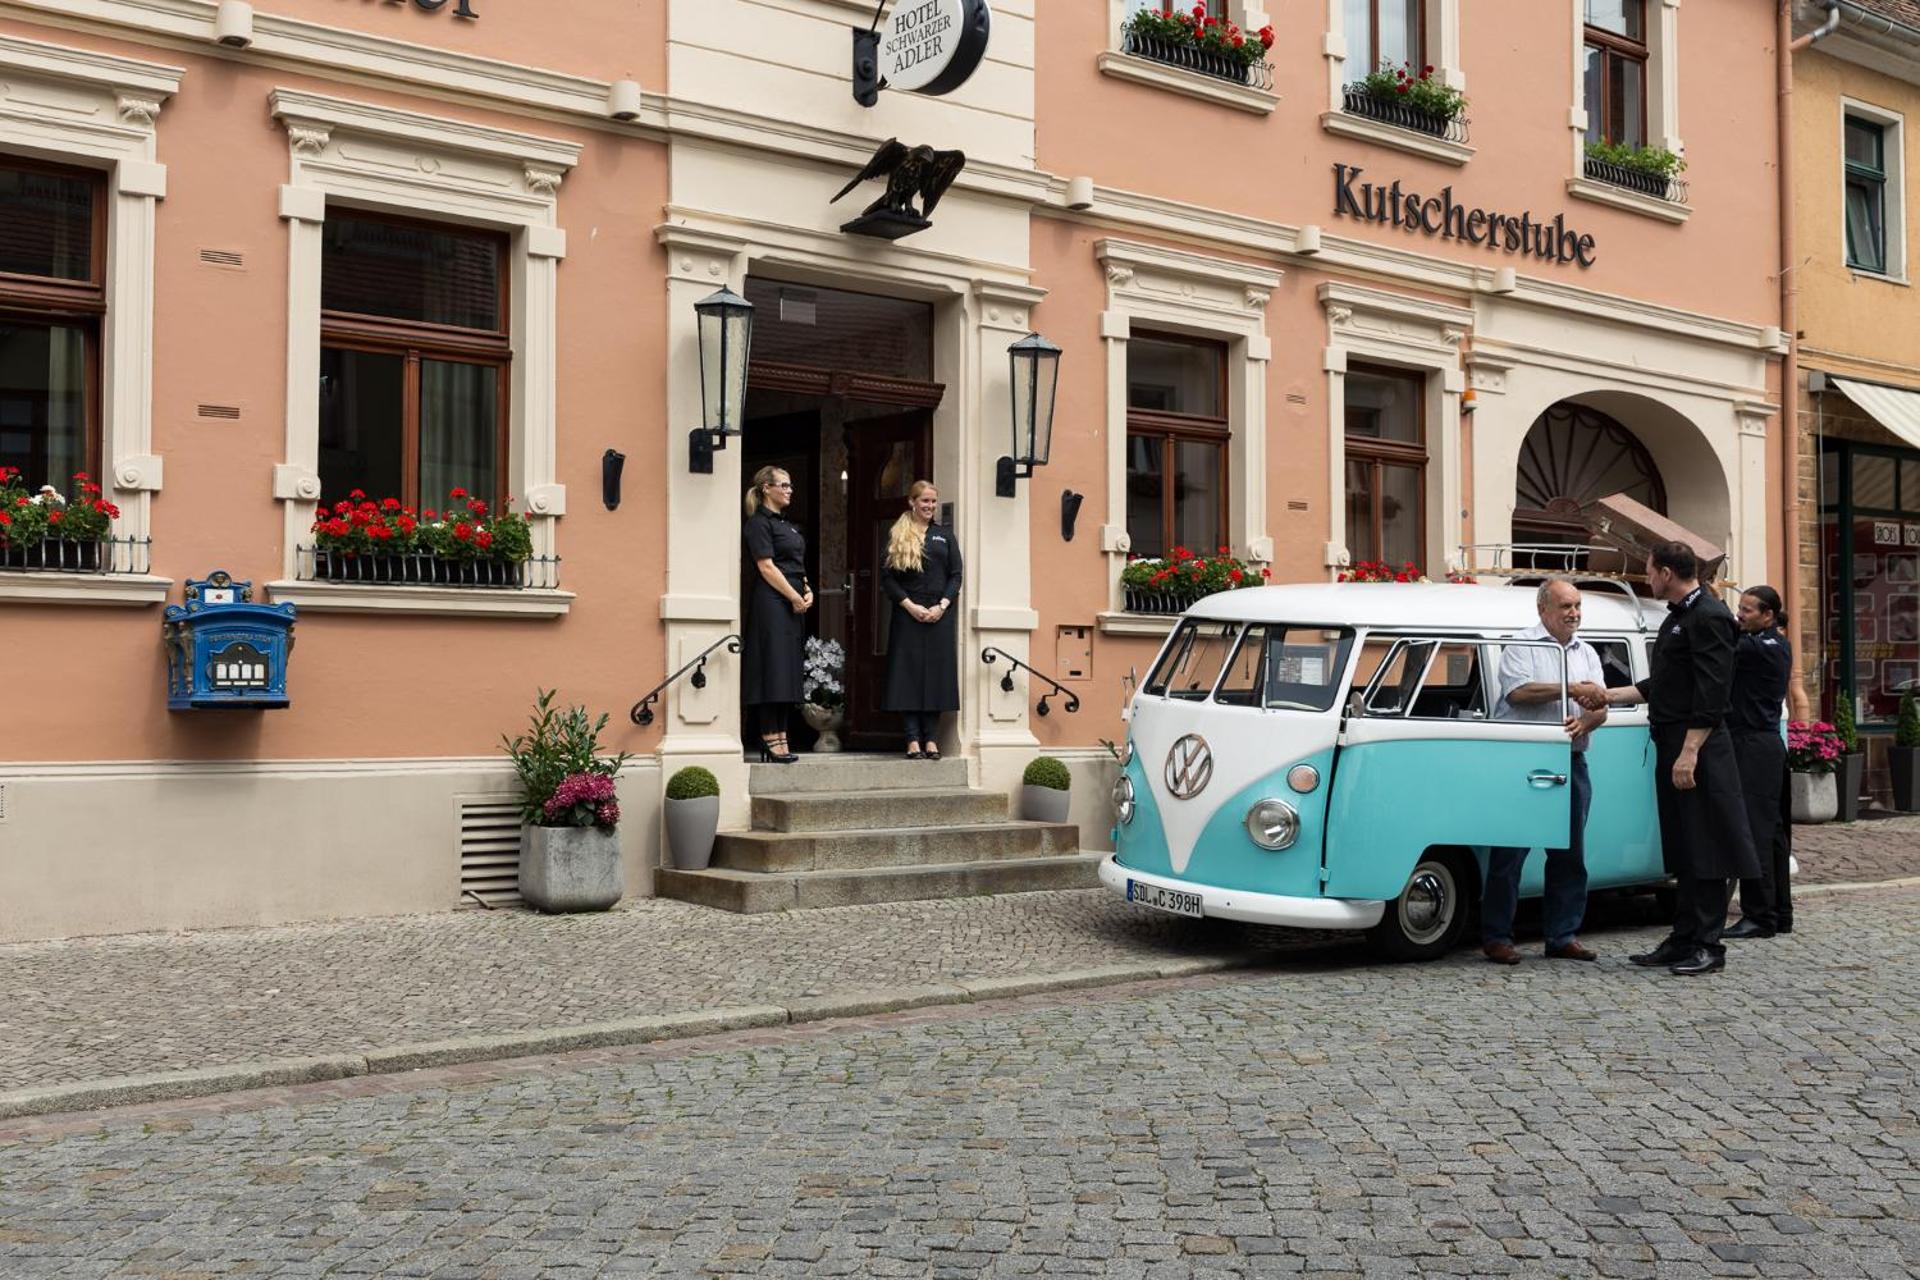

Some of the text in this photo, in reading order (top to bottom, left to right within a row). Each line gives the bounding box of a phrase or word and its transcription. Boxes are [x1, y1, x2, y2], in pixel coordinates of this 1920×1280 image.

[886, 15, 951, 56] SCHWARZER
[895, 0, 942, 34] HOTEL
[893, 35, 943, 74] ADLER
[1332, 163, 1597, 268] Kutscherstube
[1133, 883, 1152, 903] SDL
